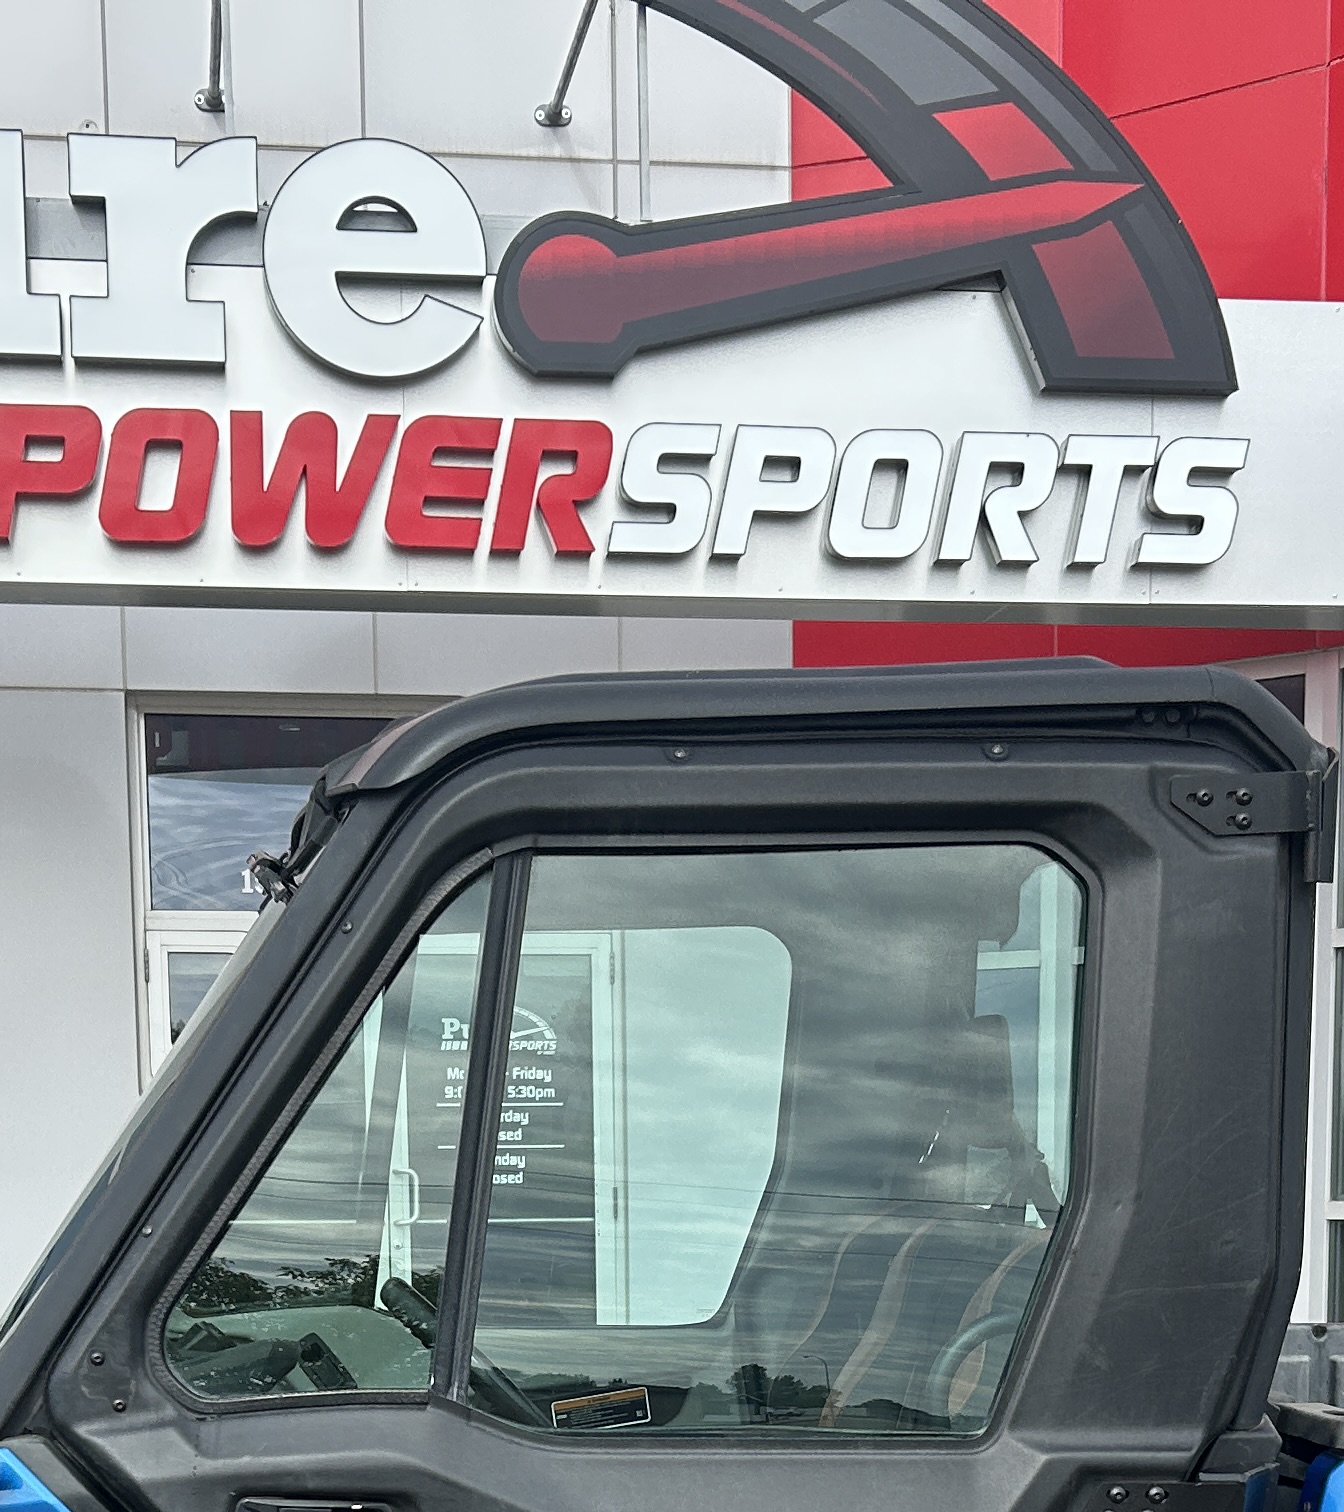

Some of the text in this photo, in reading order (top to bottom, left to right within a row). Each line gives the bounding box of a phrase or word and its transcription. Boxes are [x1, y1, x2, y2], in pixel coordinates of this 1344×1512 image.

[512, 1066, 552, 1083] Friday
[507, 1085, 556, 1101] 5:30pm
[500, 1110, 530, 1126] rday
[497, 1128, 523, 1141] sed
[494, 1153, 526, 1168] nday
[492, 1171, 524, 1184] osed
